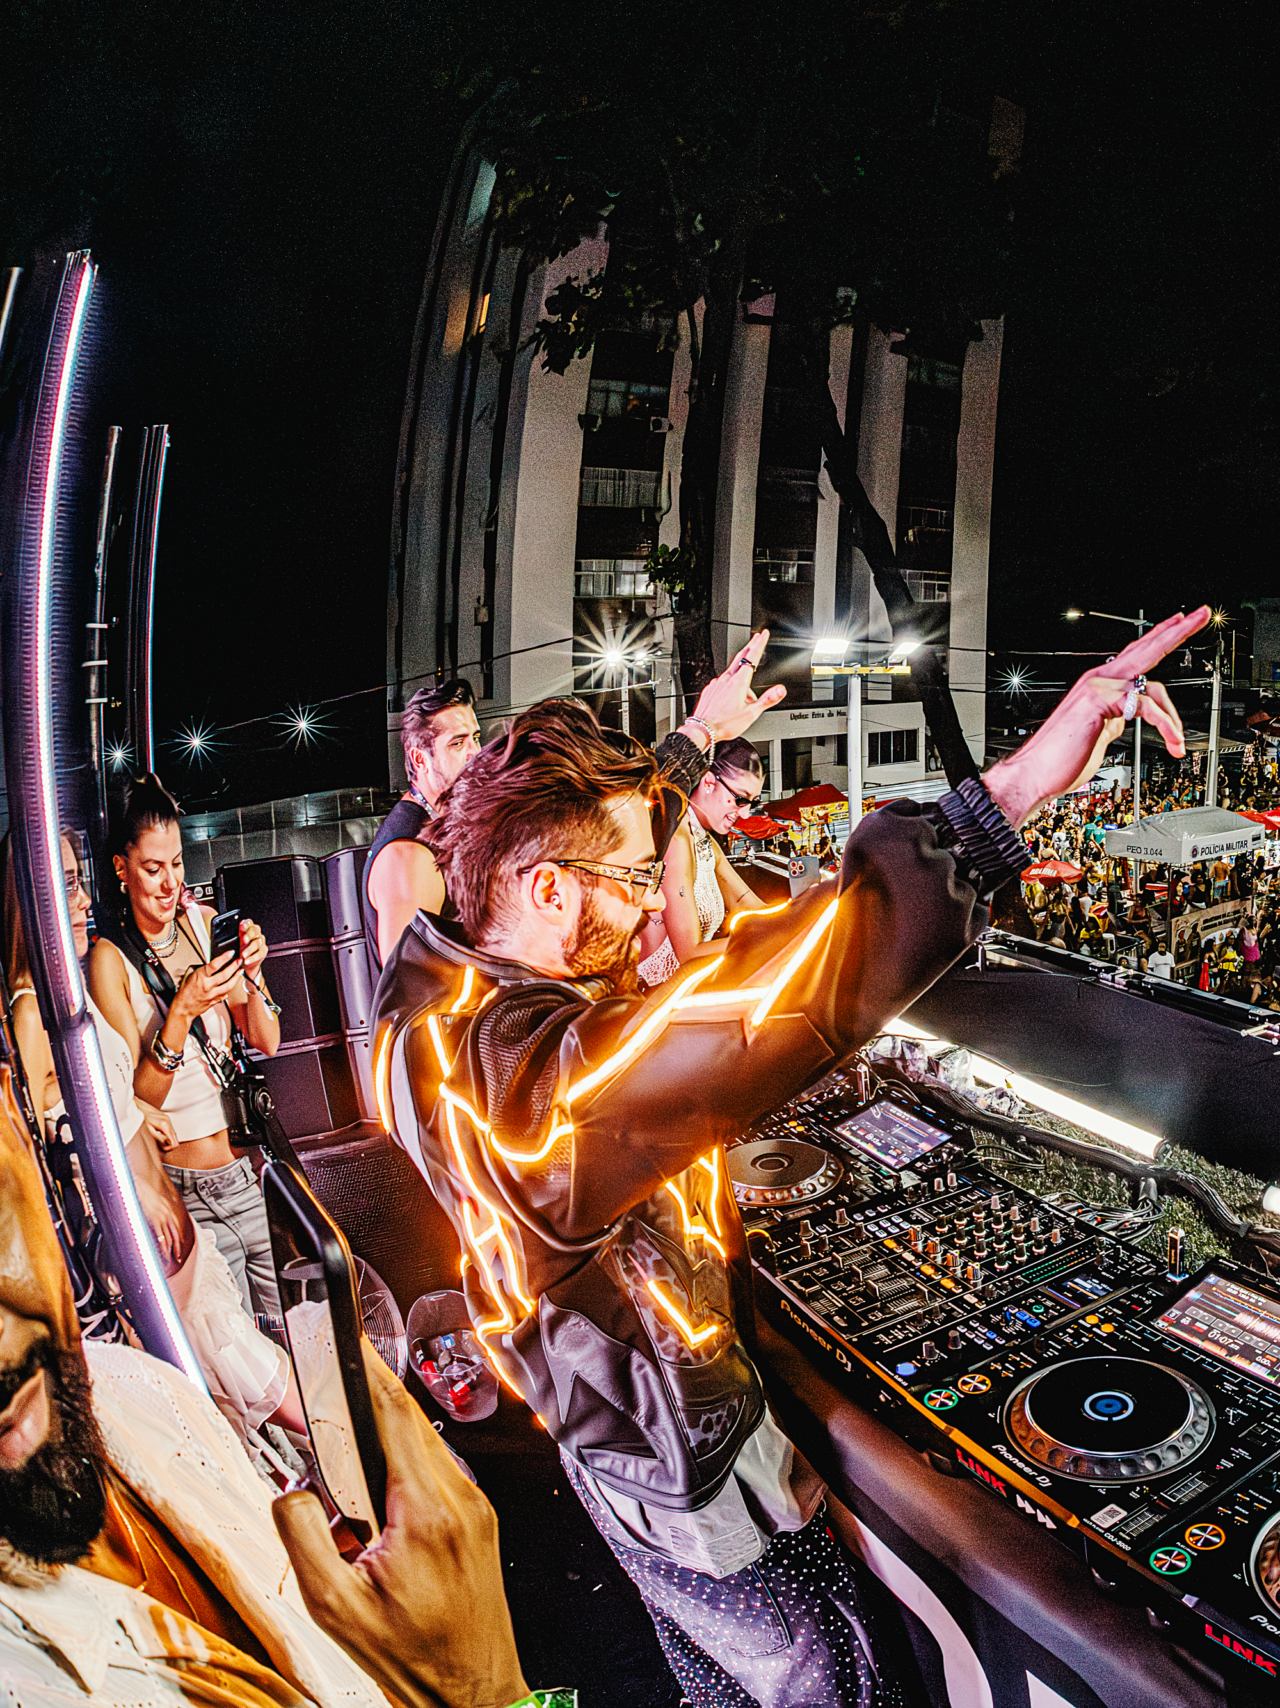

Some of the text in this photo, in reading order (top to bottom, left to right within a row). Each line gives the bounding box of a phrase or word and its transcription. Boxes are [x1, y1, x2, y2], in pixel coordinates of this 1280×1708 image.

[1225, 839, 1249, 851] MILITAR
[780, 1299, 852, 1373] Pioneer DJ
[955, 1447, 1007, 1498] LINK
[991, 1444, 1053, 1487] Pioneer DJ
[1204, 1622, 1278, 1677] LINK
